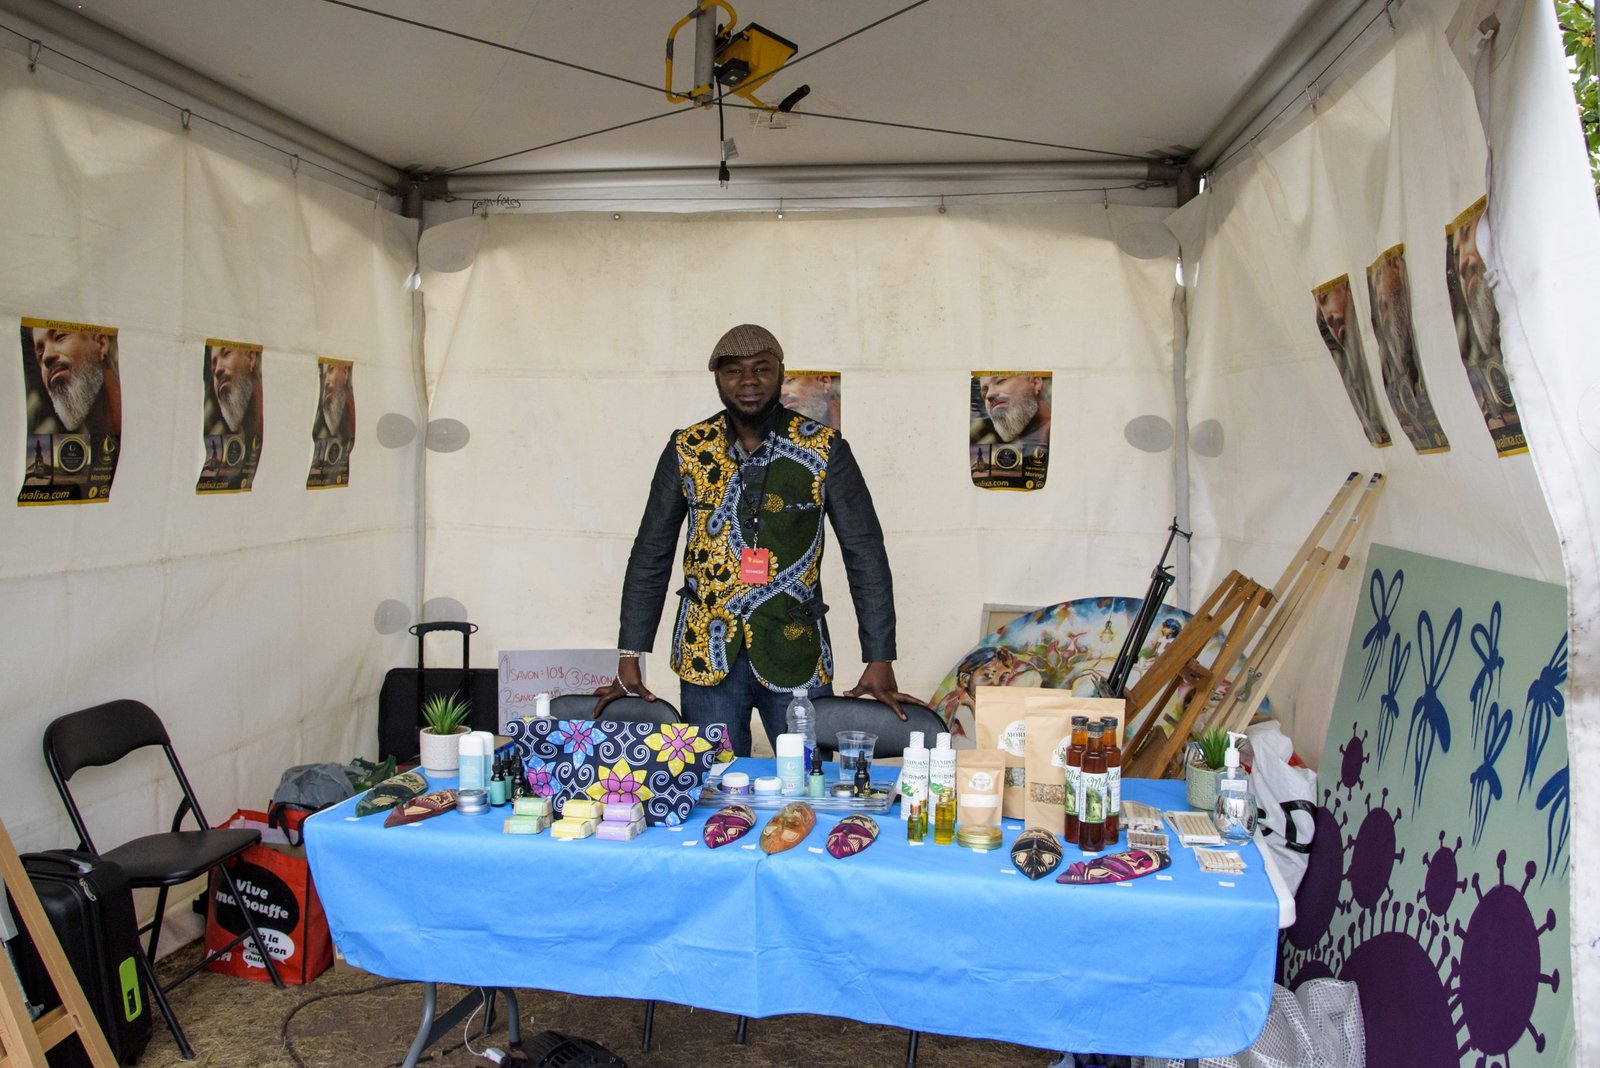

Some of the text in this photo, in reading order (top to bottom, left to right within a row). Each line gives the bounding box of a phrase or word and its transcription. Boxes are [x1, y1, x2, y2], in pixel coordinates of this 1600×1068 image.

[20, 489, 70, 500] walixa.com
[511, 668, 540, 681] SAVON
[237, 879, 269, 899] Vive
[216, 891, 236, 905] ma
[269, 934, 278, 943] la
[248, 943, 287, 955] mison
